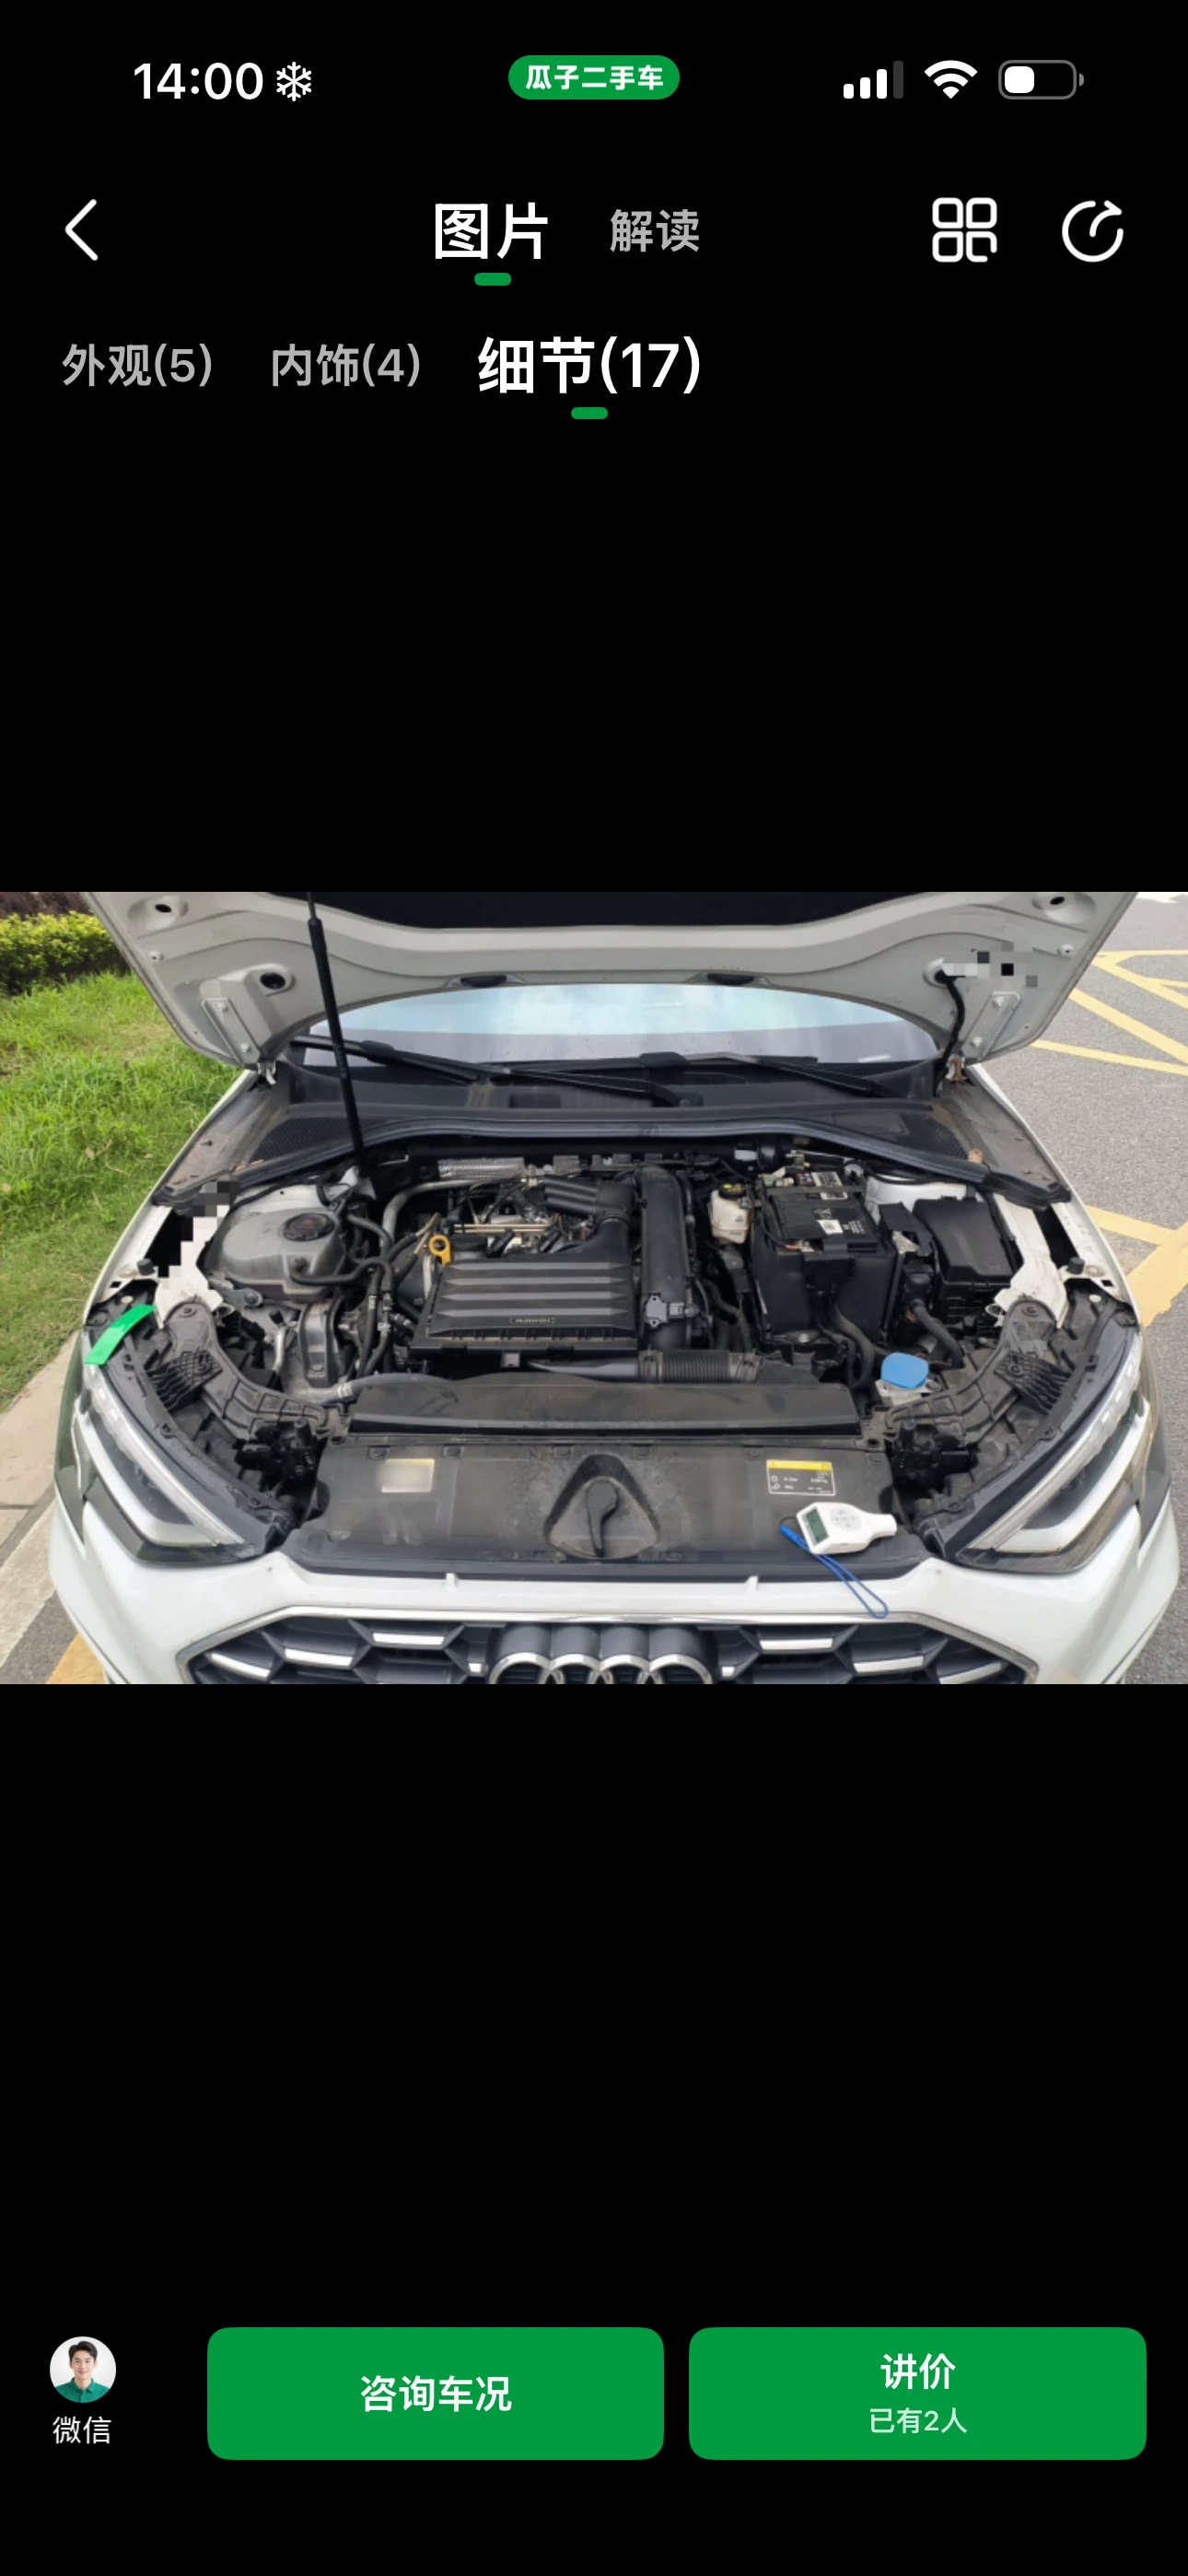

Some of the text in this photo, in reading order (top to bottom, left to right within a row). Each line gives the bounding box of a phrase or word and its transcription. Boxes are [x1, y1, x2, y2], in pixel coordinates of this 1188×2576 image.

[134, 63, 263, 100] 14:00
[526, 64, 664, 91] 瓜子二手车
[435, 201, 549, 260] 图片
[610, 208, 700, 252] 解读
[63, 343, 212, 387] 外观(5)
[272, 343, 420, 387] 内饰(4)
[477, 335, 700, 394] 细节(17)
[879, 2352, 956, 2390] 讲价
[360, 2374, 513, 2413] 咨询车况
[52, 2416, 112, 2444] 微信
[869, 2406, 968, 2434] 已有2人
